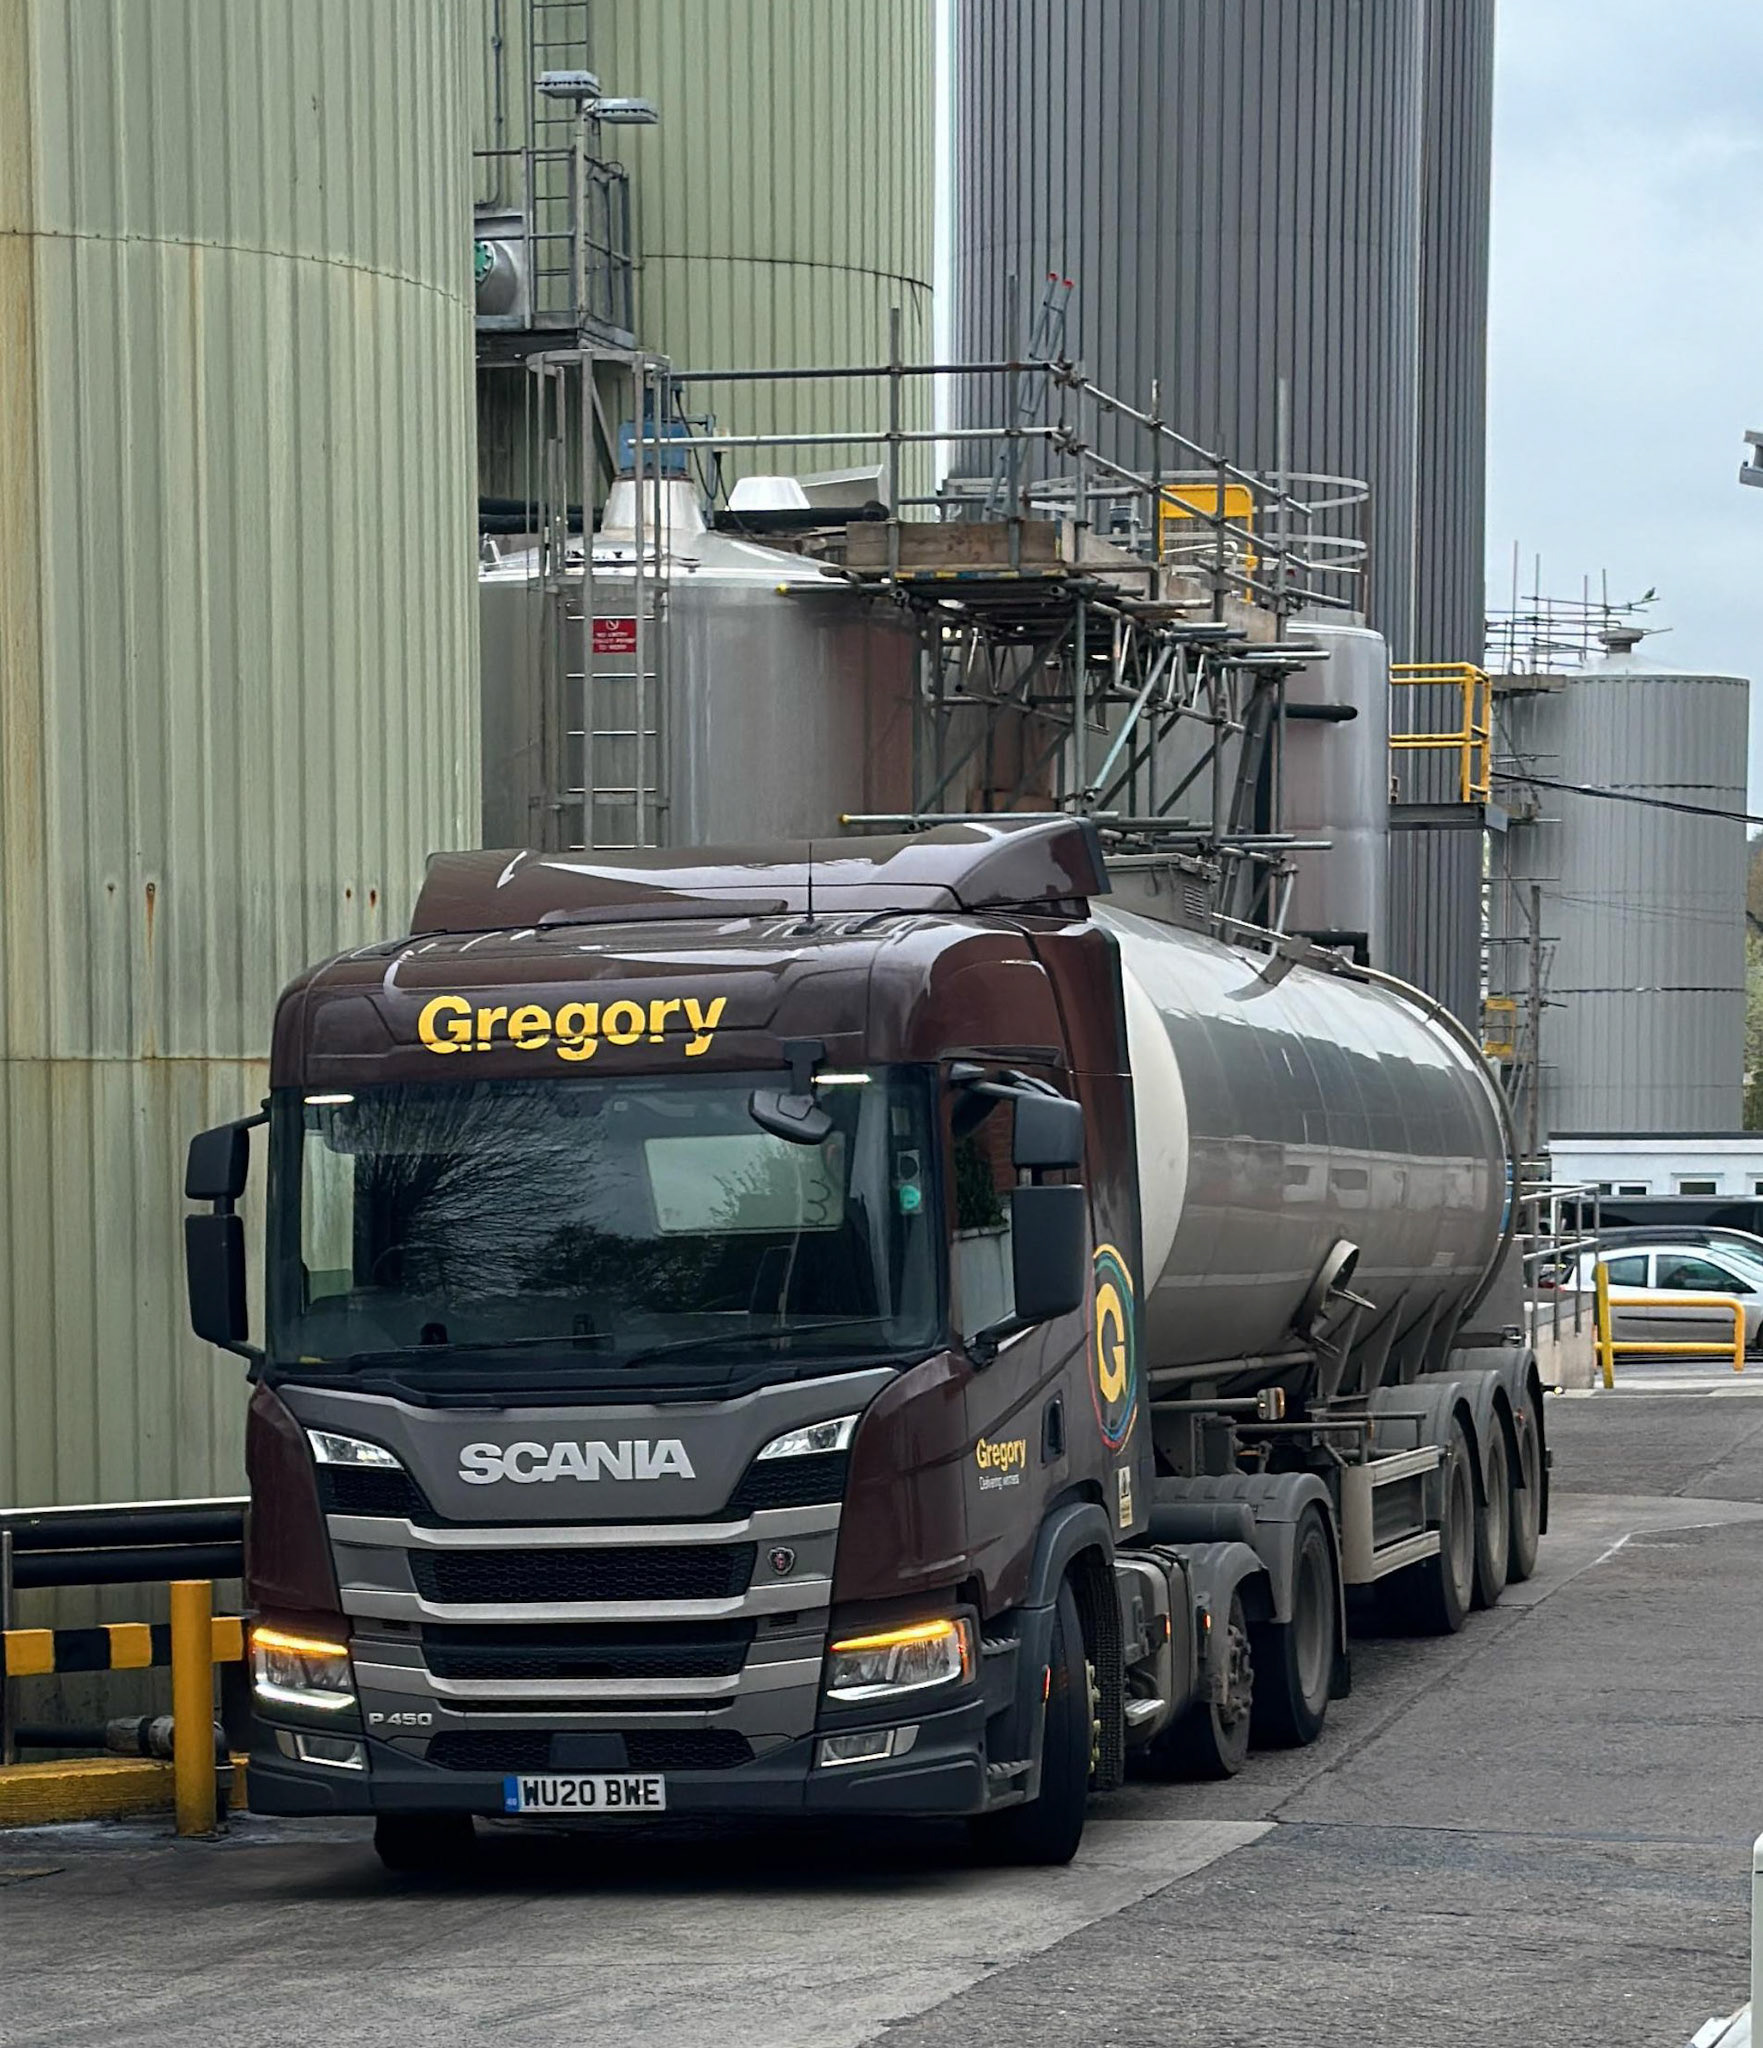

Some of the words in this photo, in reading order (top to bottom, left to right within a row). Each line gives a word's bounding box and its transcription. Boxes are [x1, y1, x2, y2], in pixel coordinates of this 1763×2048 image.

[418, 995, 728, 1061] Gregory
[457, 1438, 697, 1484] SCANIA
[976, 1438, 1026, 1471] Gregory
[522, 1779, 595, 1806] WU20
[605, 1779, 660, 1806] BWE
